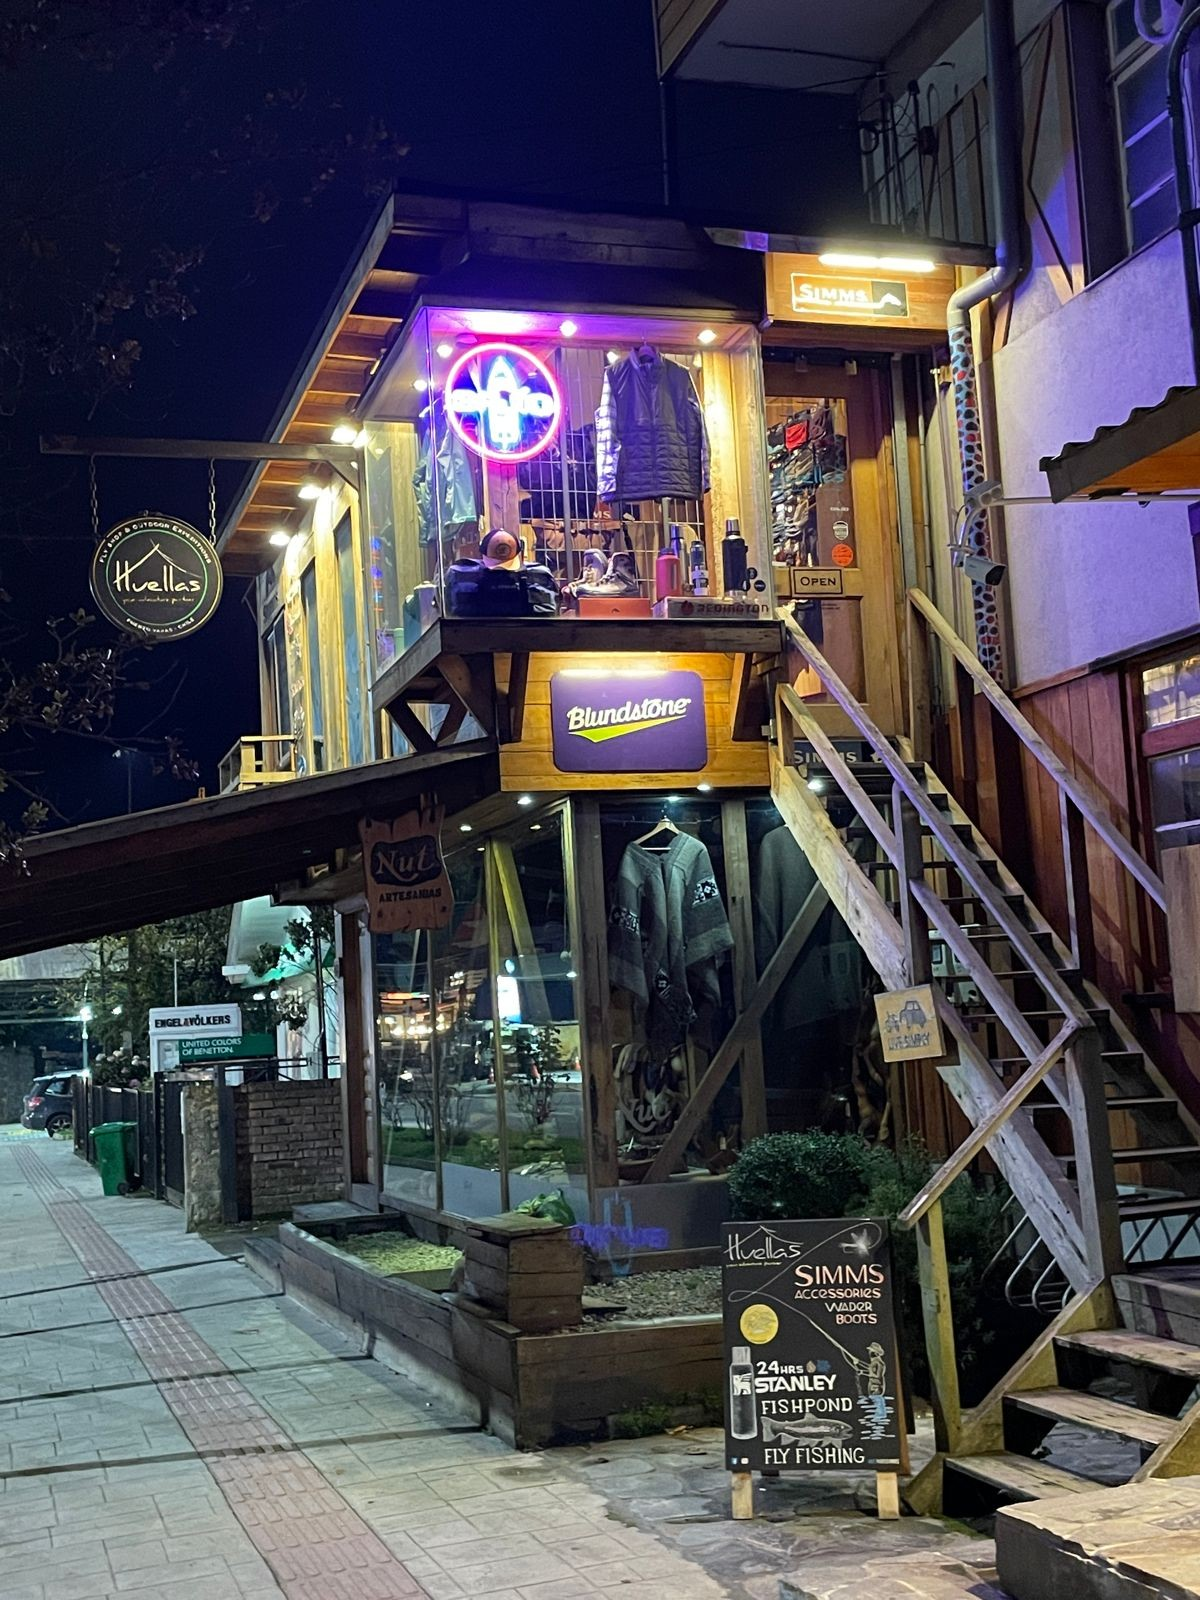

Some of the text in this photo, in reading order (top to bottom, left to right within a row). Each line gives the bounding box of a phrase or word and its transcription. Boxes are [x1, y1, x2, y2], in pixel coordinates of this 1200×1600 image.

[800, 283, 870, 302] SIMMS
[99, 549, 108, 563] FLY
[107, 531, 124, 548] SHOP
[132, 521, 170, 529] OUTDOOR
[113, 551, 202, 592] Huellas
[800, 576, 836, 586] OPEN
[567, 698, 691, 730] Blundstone
[375, 845, 435, 882] Nut
[182, 1038, 241, 1048] UNITED COLORS
[724, 1229, 802, 1261] Huellas
[794, 1264, 885, 1286] SIMMS
[836, 1313, 878, 1324] BOOTS
[754, 1374, 837, 1394] STANLEY
[761, 1397, 853, 1415] FISHPOND
[764, 1447, 865, 1465] FLY FISHING
